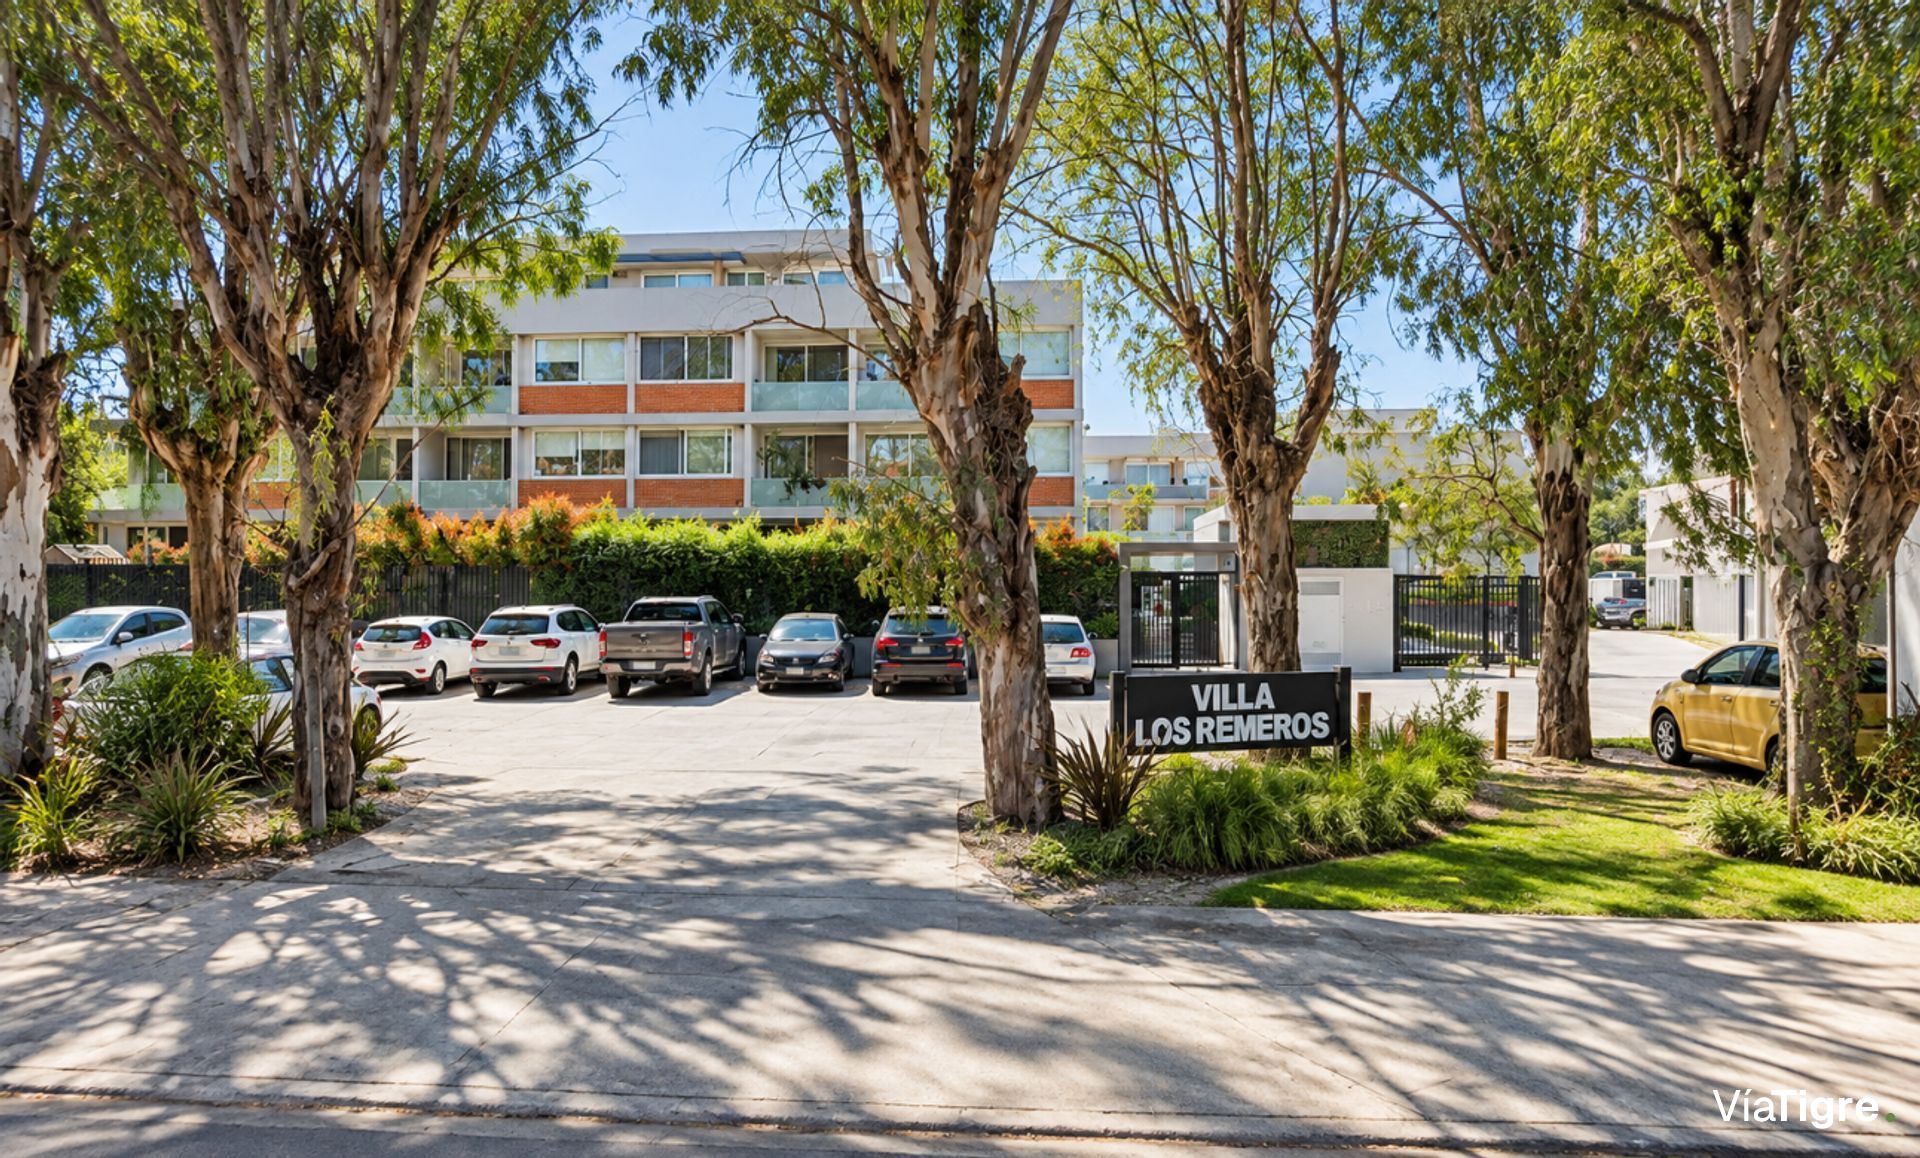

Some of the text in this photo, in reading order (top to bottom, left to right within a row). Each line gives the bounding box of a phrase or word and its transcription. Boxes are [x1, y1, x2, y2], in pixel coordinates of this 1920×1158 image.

[1191, 682, 1275, 712] VILLA
[1135, 711, 1330, 747] LOS REMEROS
